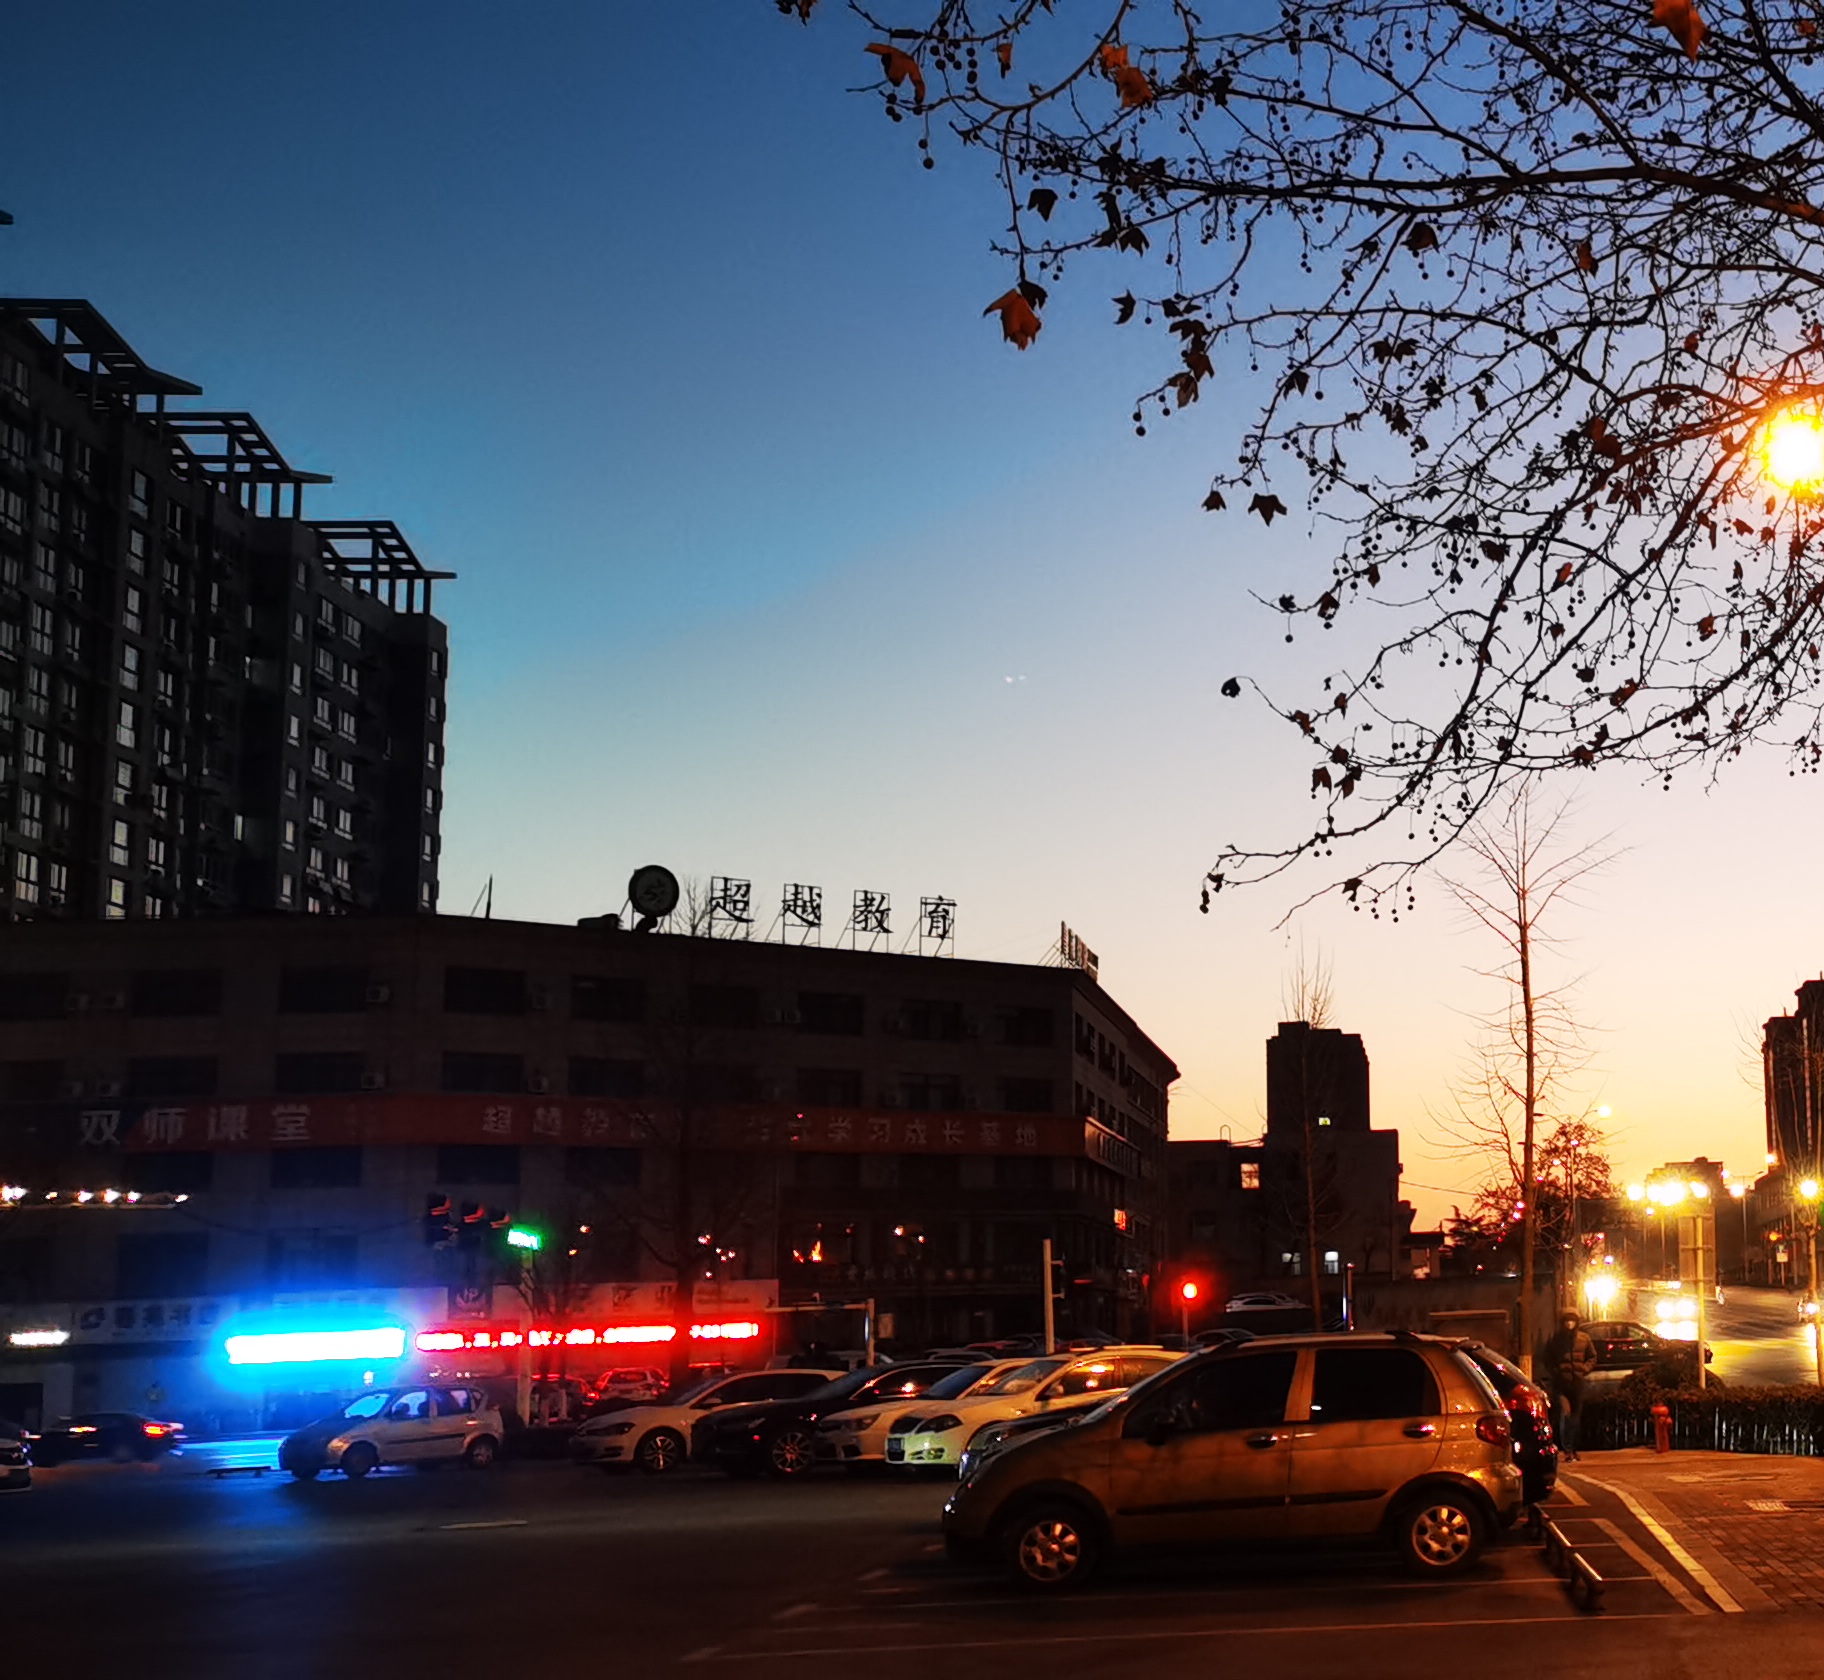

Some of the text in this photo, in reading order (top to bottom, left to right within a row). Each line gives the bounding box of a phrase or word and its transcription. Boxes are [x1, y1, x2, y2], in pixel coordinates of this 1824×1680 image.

[709, 877, 957, 939] 超越教育
[80, 1104, 311, 1146] 双师课堂
